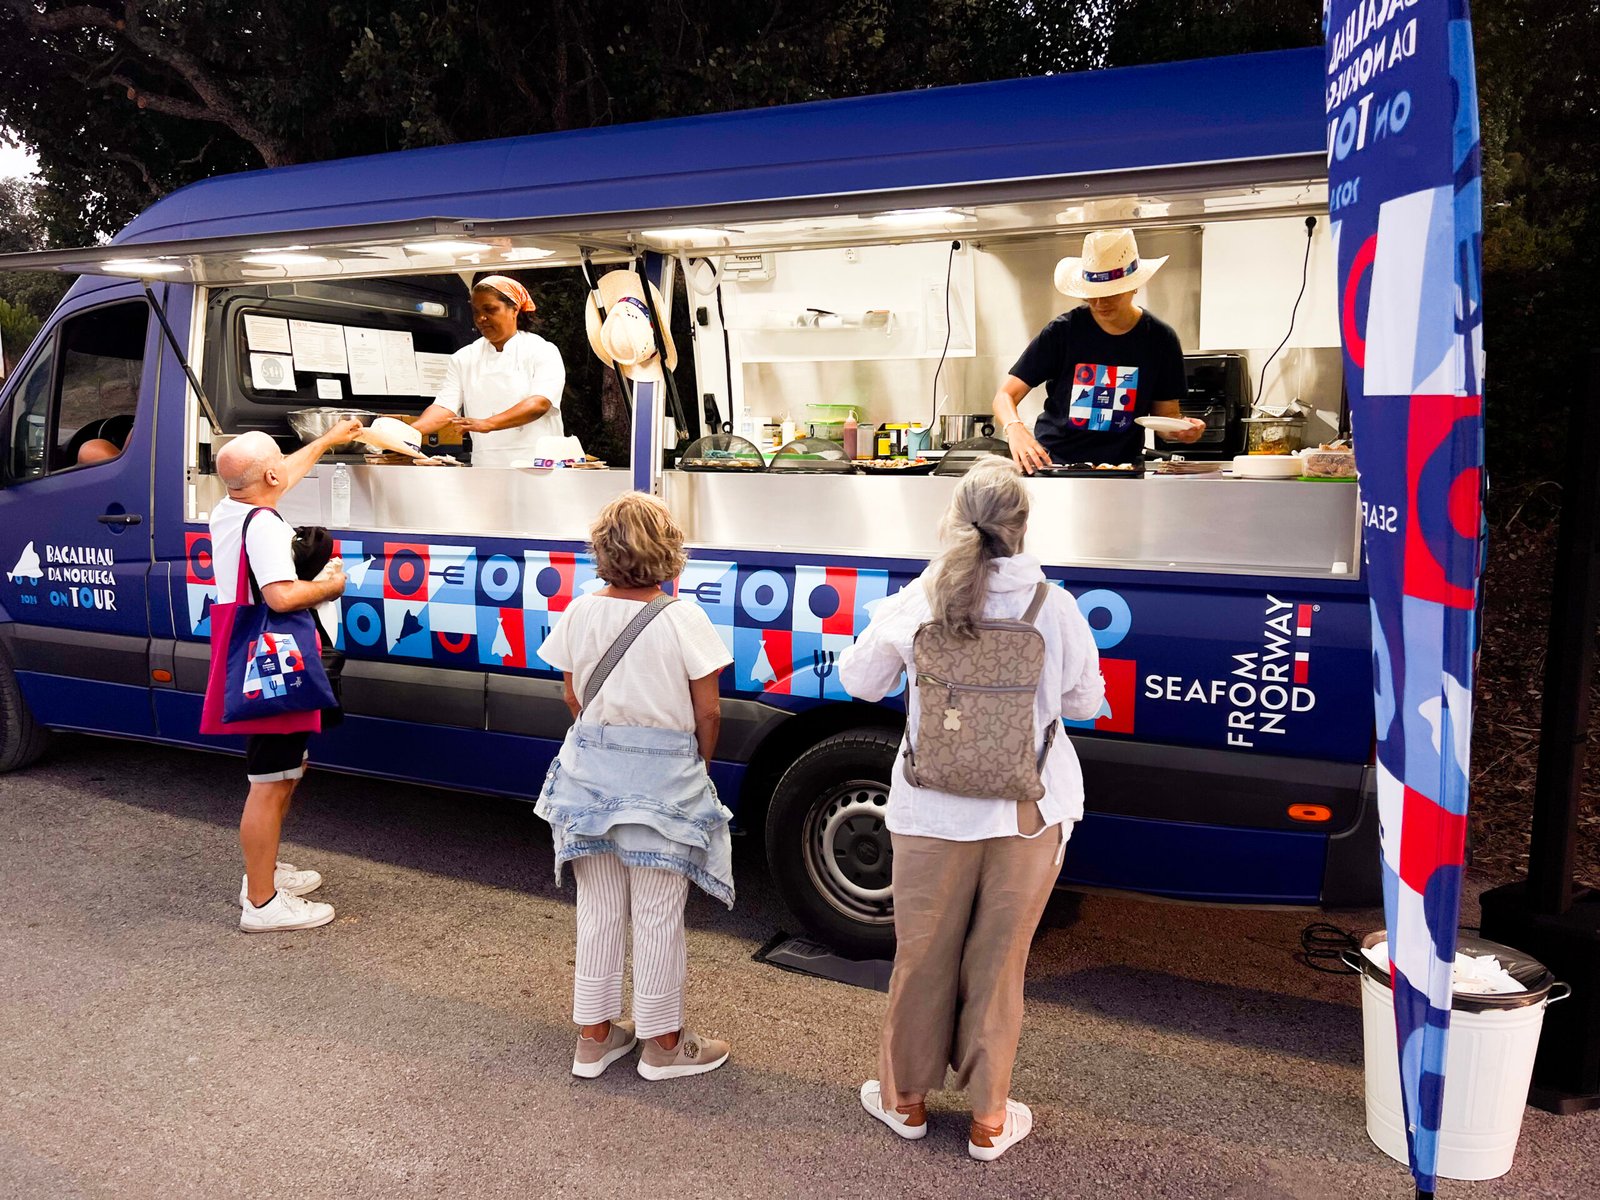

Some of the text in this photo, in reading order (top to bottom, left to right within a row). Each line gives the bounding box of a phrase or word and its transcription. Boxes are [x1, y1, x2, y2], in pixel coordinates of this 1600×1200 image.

[46, 545, 114, 566] BACALHAU
[48, 567, 116, 586] DA NORUEGA
[49, 586, 117, 611] ON TOUR
[1258, 593, 1294, 734] NORWAY
[1144, 674, 1316, 712] SEAFOOD
[1227, 652, 1259, 747] FROM
